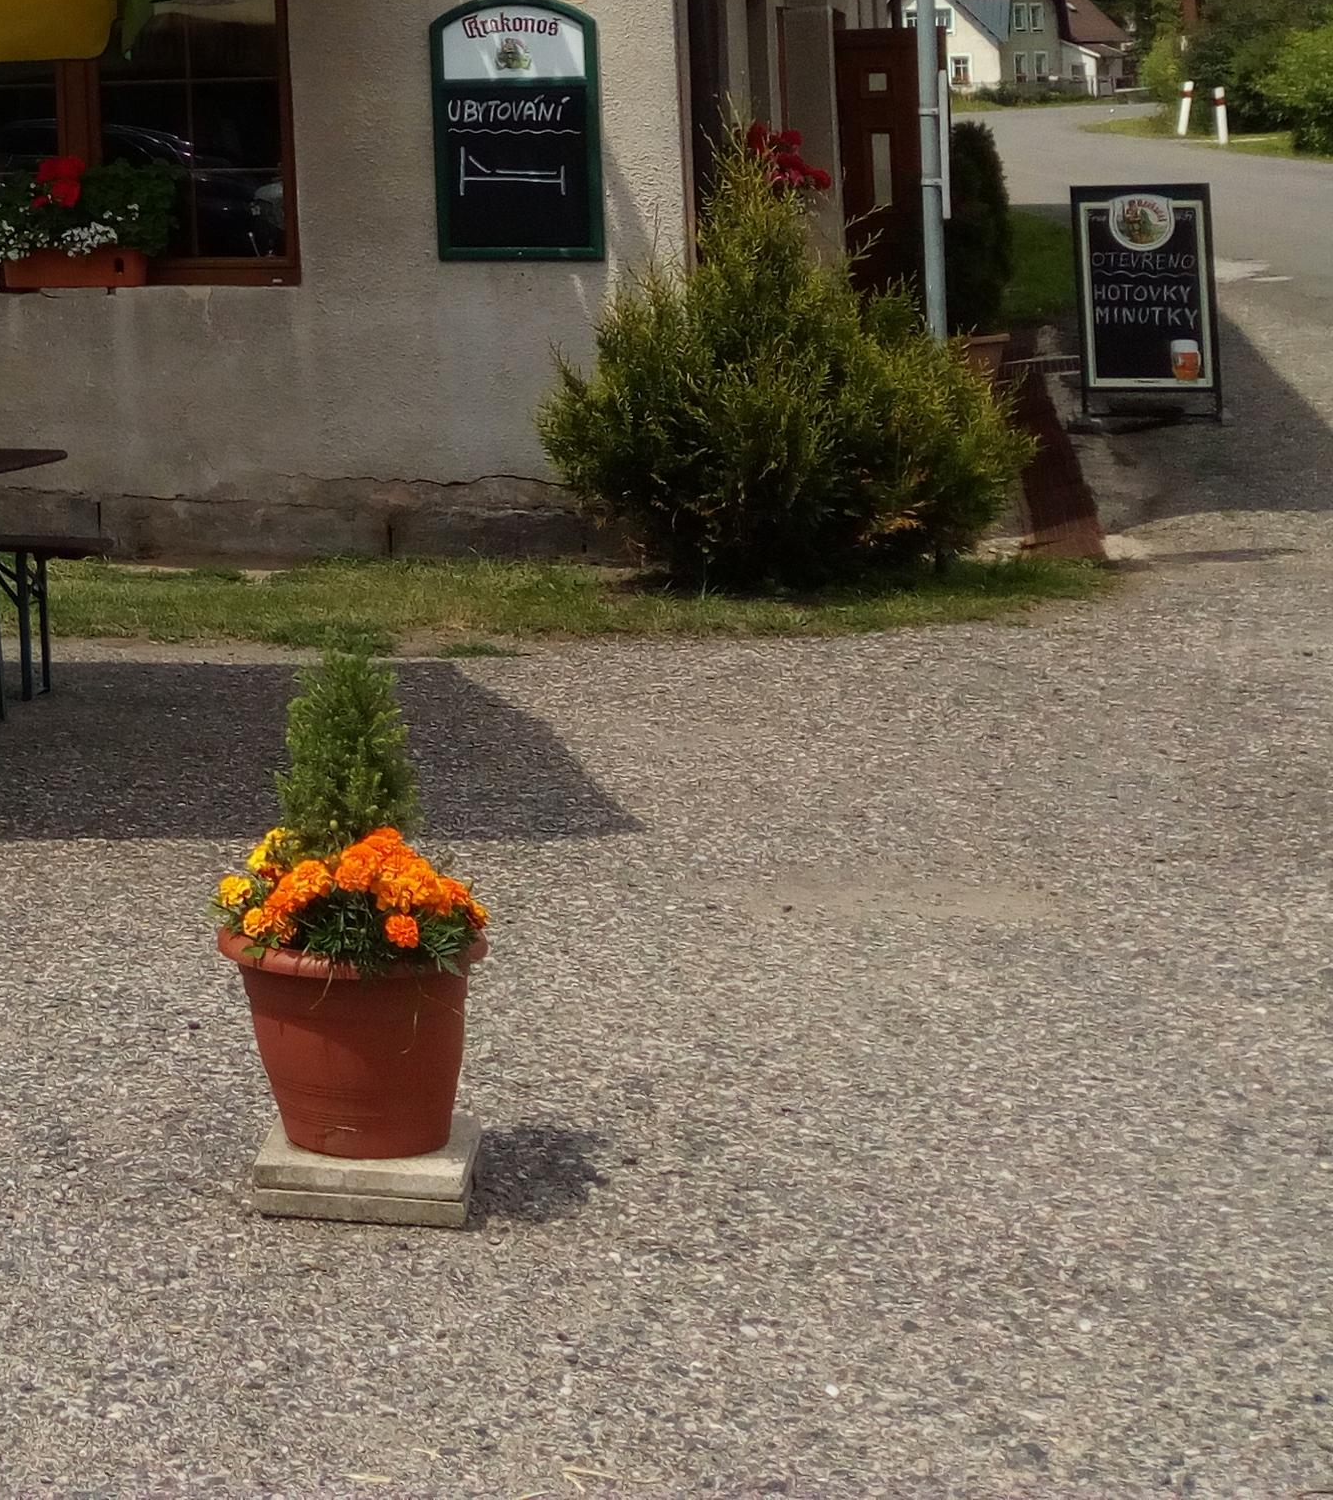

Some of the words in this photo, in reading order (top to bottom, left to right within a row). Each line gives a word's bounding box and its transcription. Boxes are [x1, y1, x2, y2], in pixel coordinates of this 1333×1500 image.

[461, 12, 562, 39] Krakonoš
[447, 94, 571, 124] UBYTOVÁNÍ
[1093, 283, 1192, 304] HOTOVKY
[1094, 305, 1198, 330] MINUTKY
